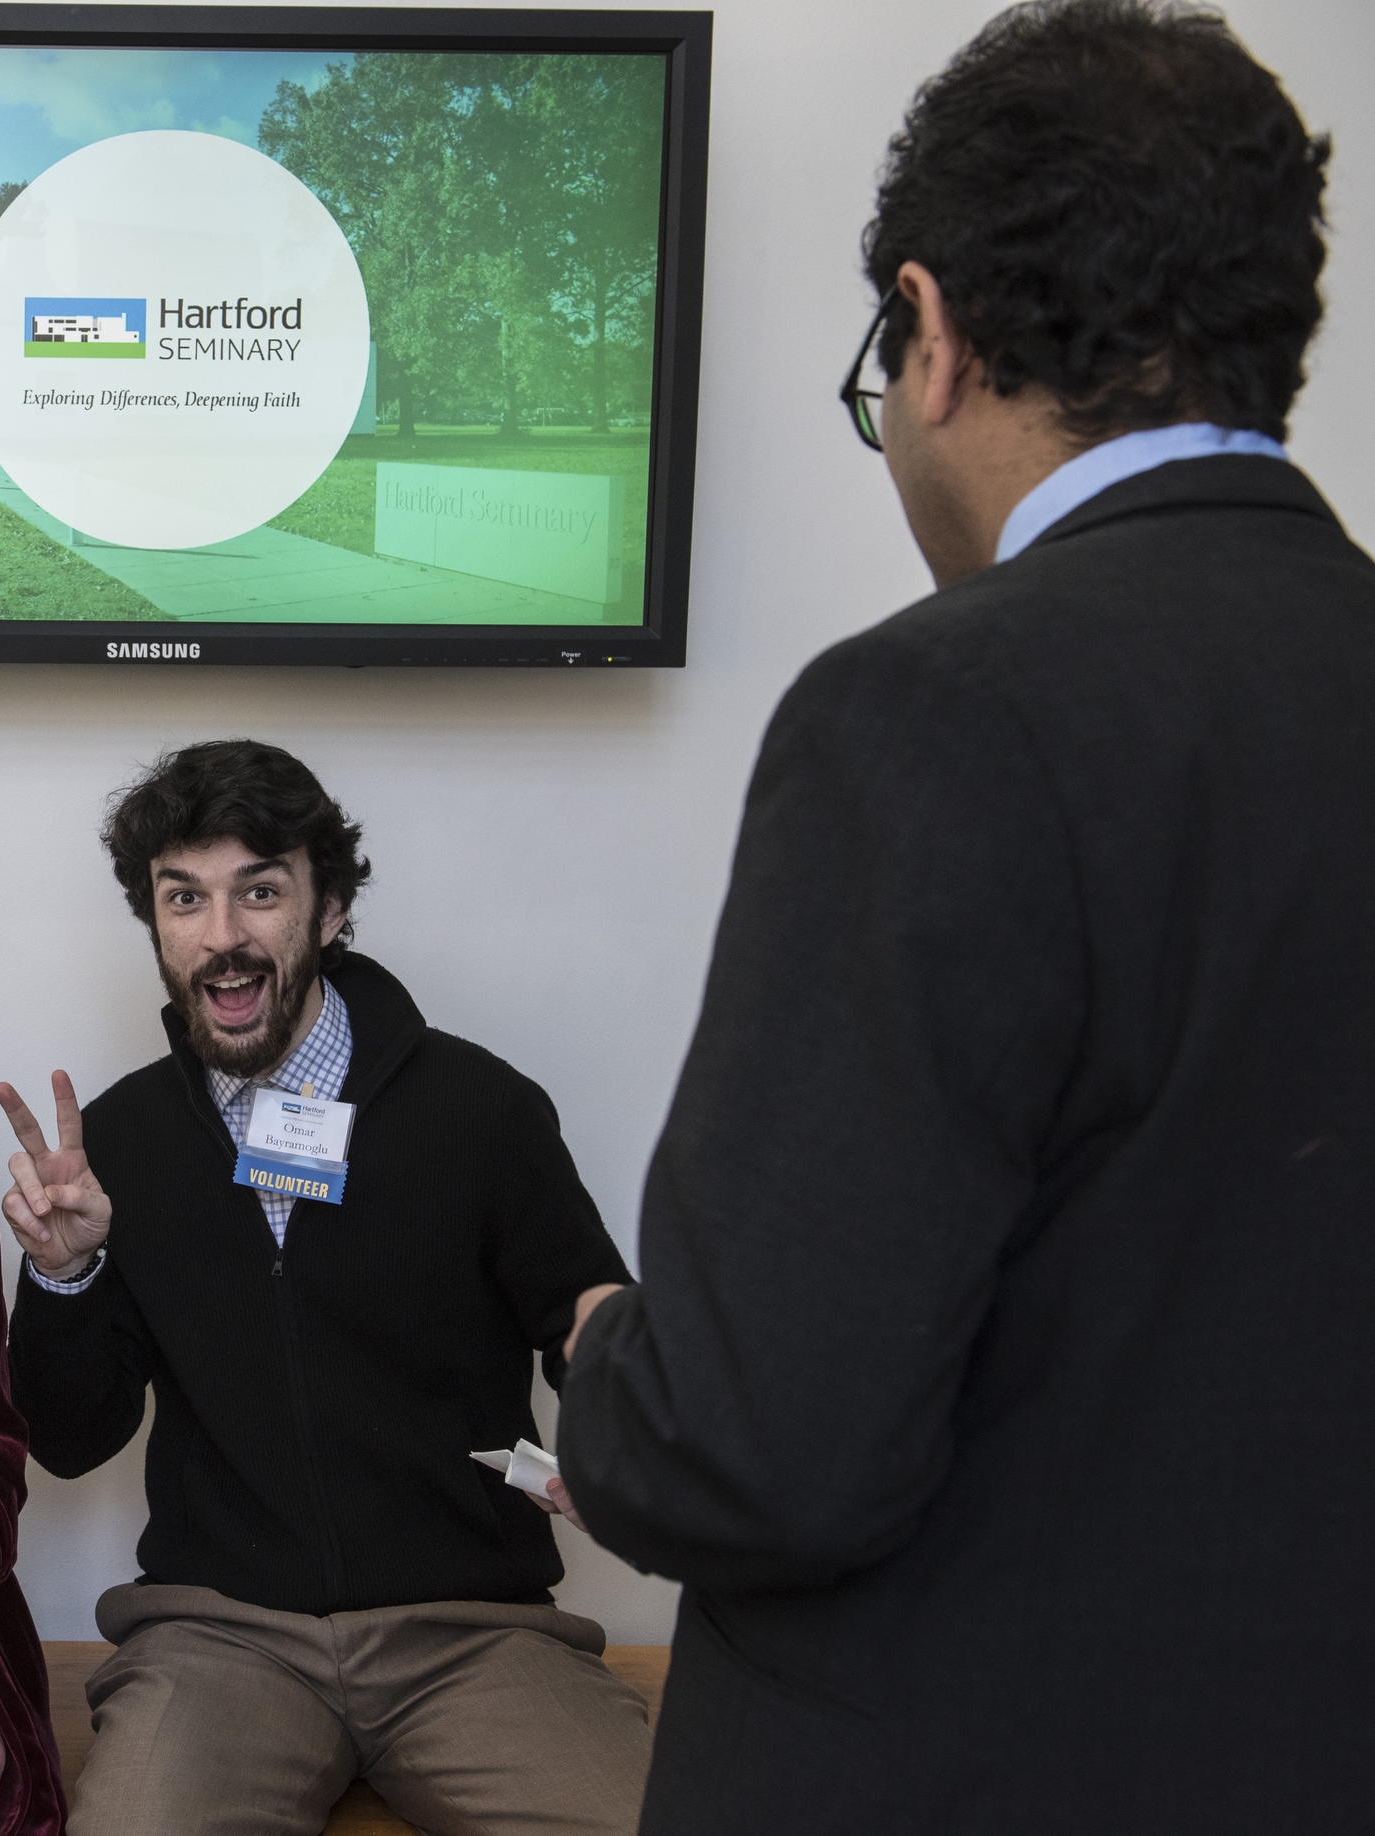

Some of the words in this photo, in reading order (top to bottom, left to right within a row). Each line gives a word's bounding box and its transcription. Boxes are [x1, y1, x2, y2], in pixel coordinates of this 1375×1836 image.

[159, 297, 303, 330] Hartford
[158, 337, 302, 362] SEMINARY
[22, 389, 95, 410] Exploring
[100, 389, 181, 412] Differences,
[184, 391, 260, 412] Deepening
[263, 391, 301, 408] Faith
[384, 480, 464, 520] Hartford
[470, 489, 598, 545] Seminary
[106, 642, 201, 659] SAMSUNG
[302, 1105, 326, 1115] Hartford
[283, 1123, 316, 1137] Omar
[265, 1134, 329, 1156] Bayramoglu
[249, 1168, 330, 1199] VOLUNTEER
